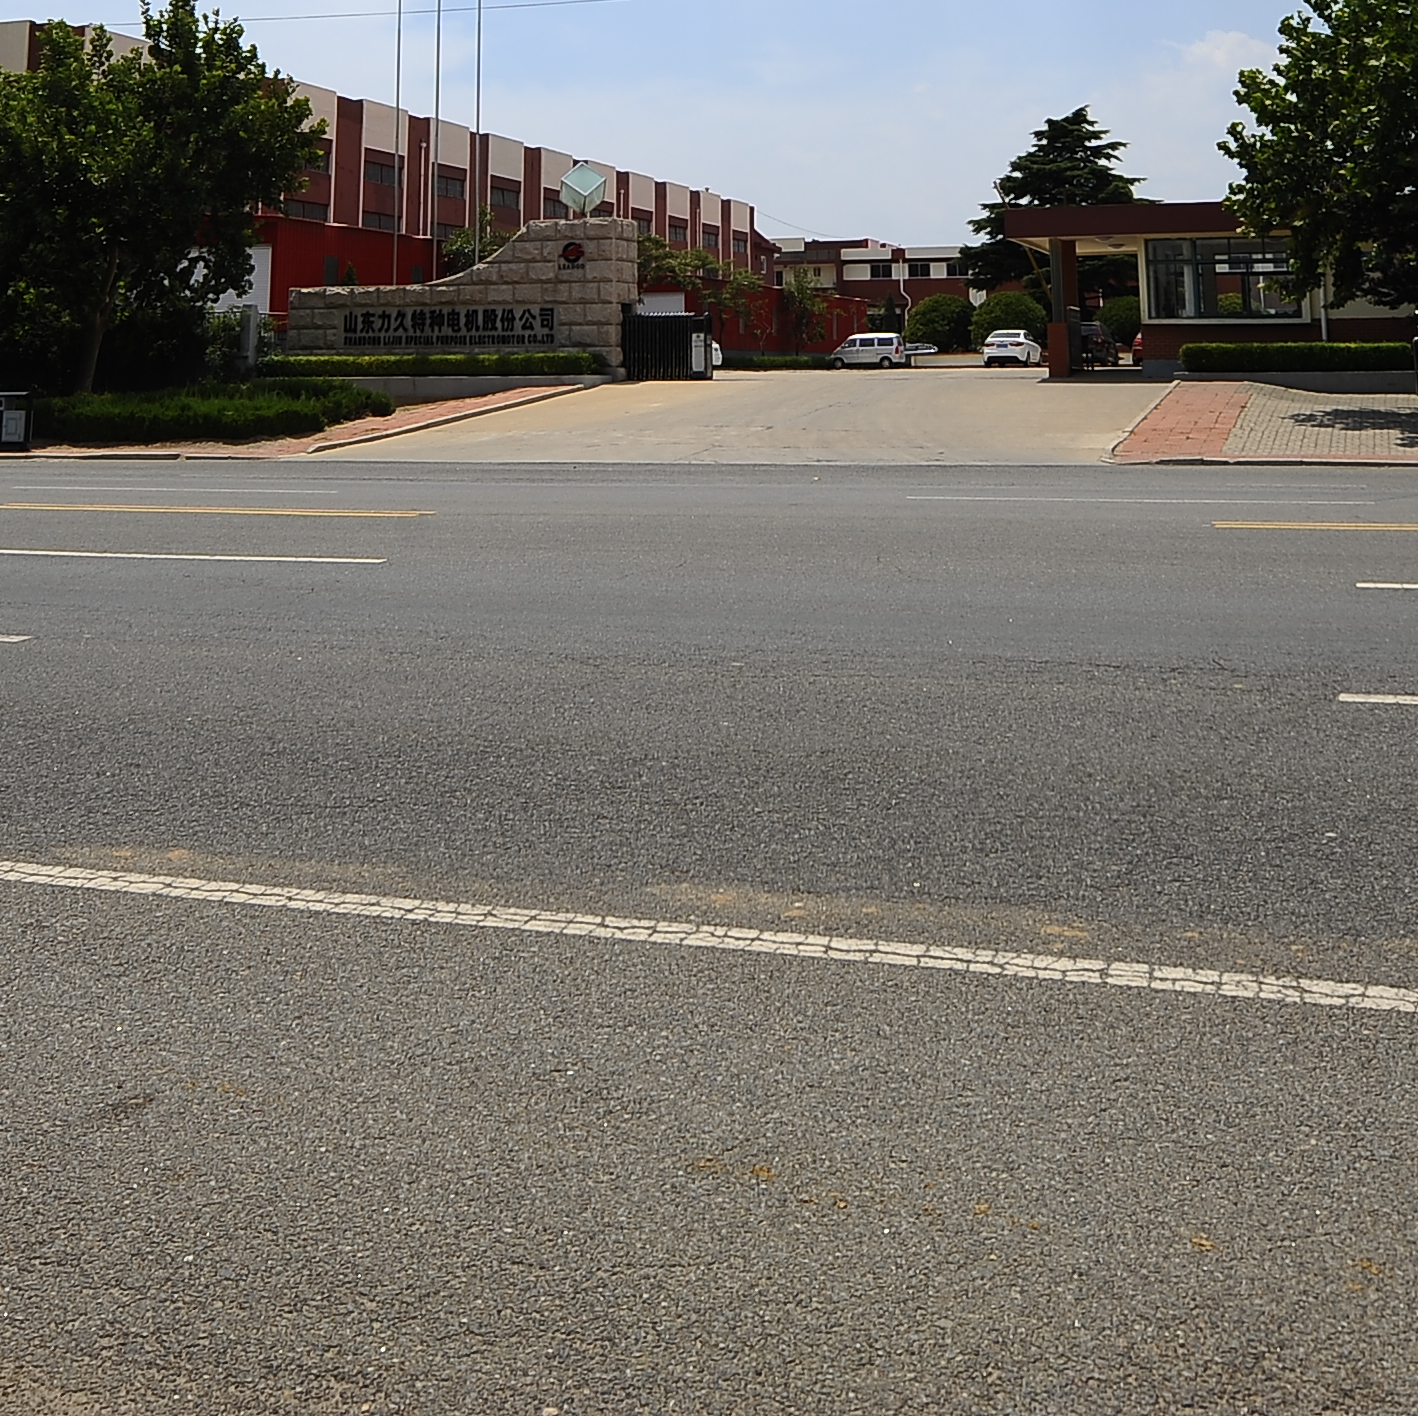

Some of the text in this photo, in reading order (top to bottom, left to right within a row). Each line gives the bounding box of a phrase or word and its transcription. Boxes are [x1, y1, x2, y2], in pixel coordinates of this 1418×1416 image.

[344, 308, 554, 333] 山东力久特种电机股份公司
[405, 335, 434, 346] SPECIAL
[436, 334, 467, 346] PURPOSE
[469, 334, 526, 345] ELECTROMOTOR
